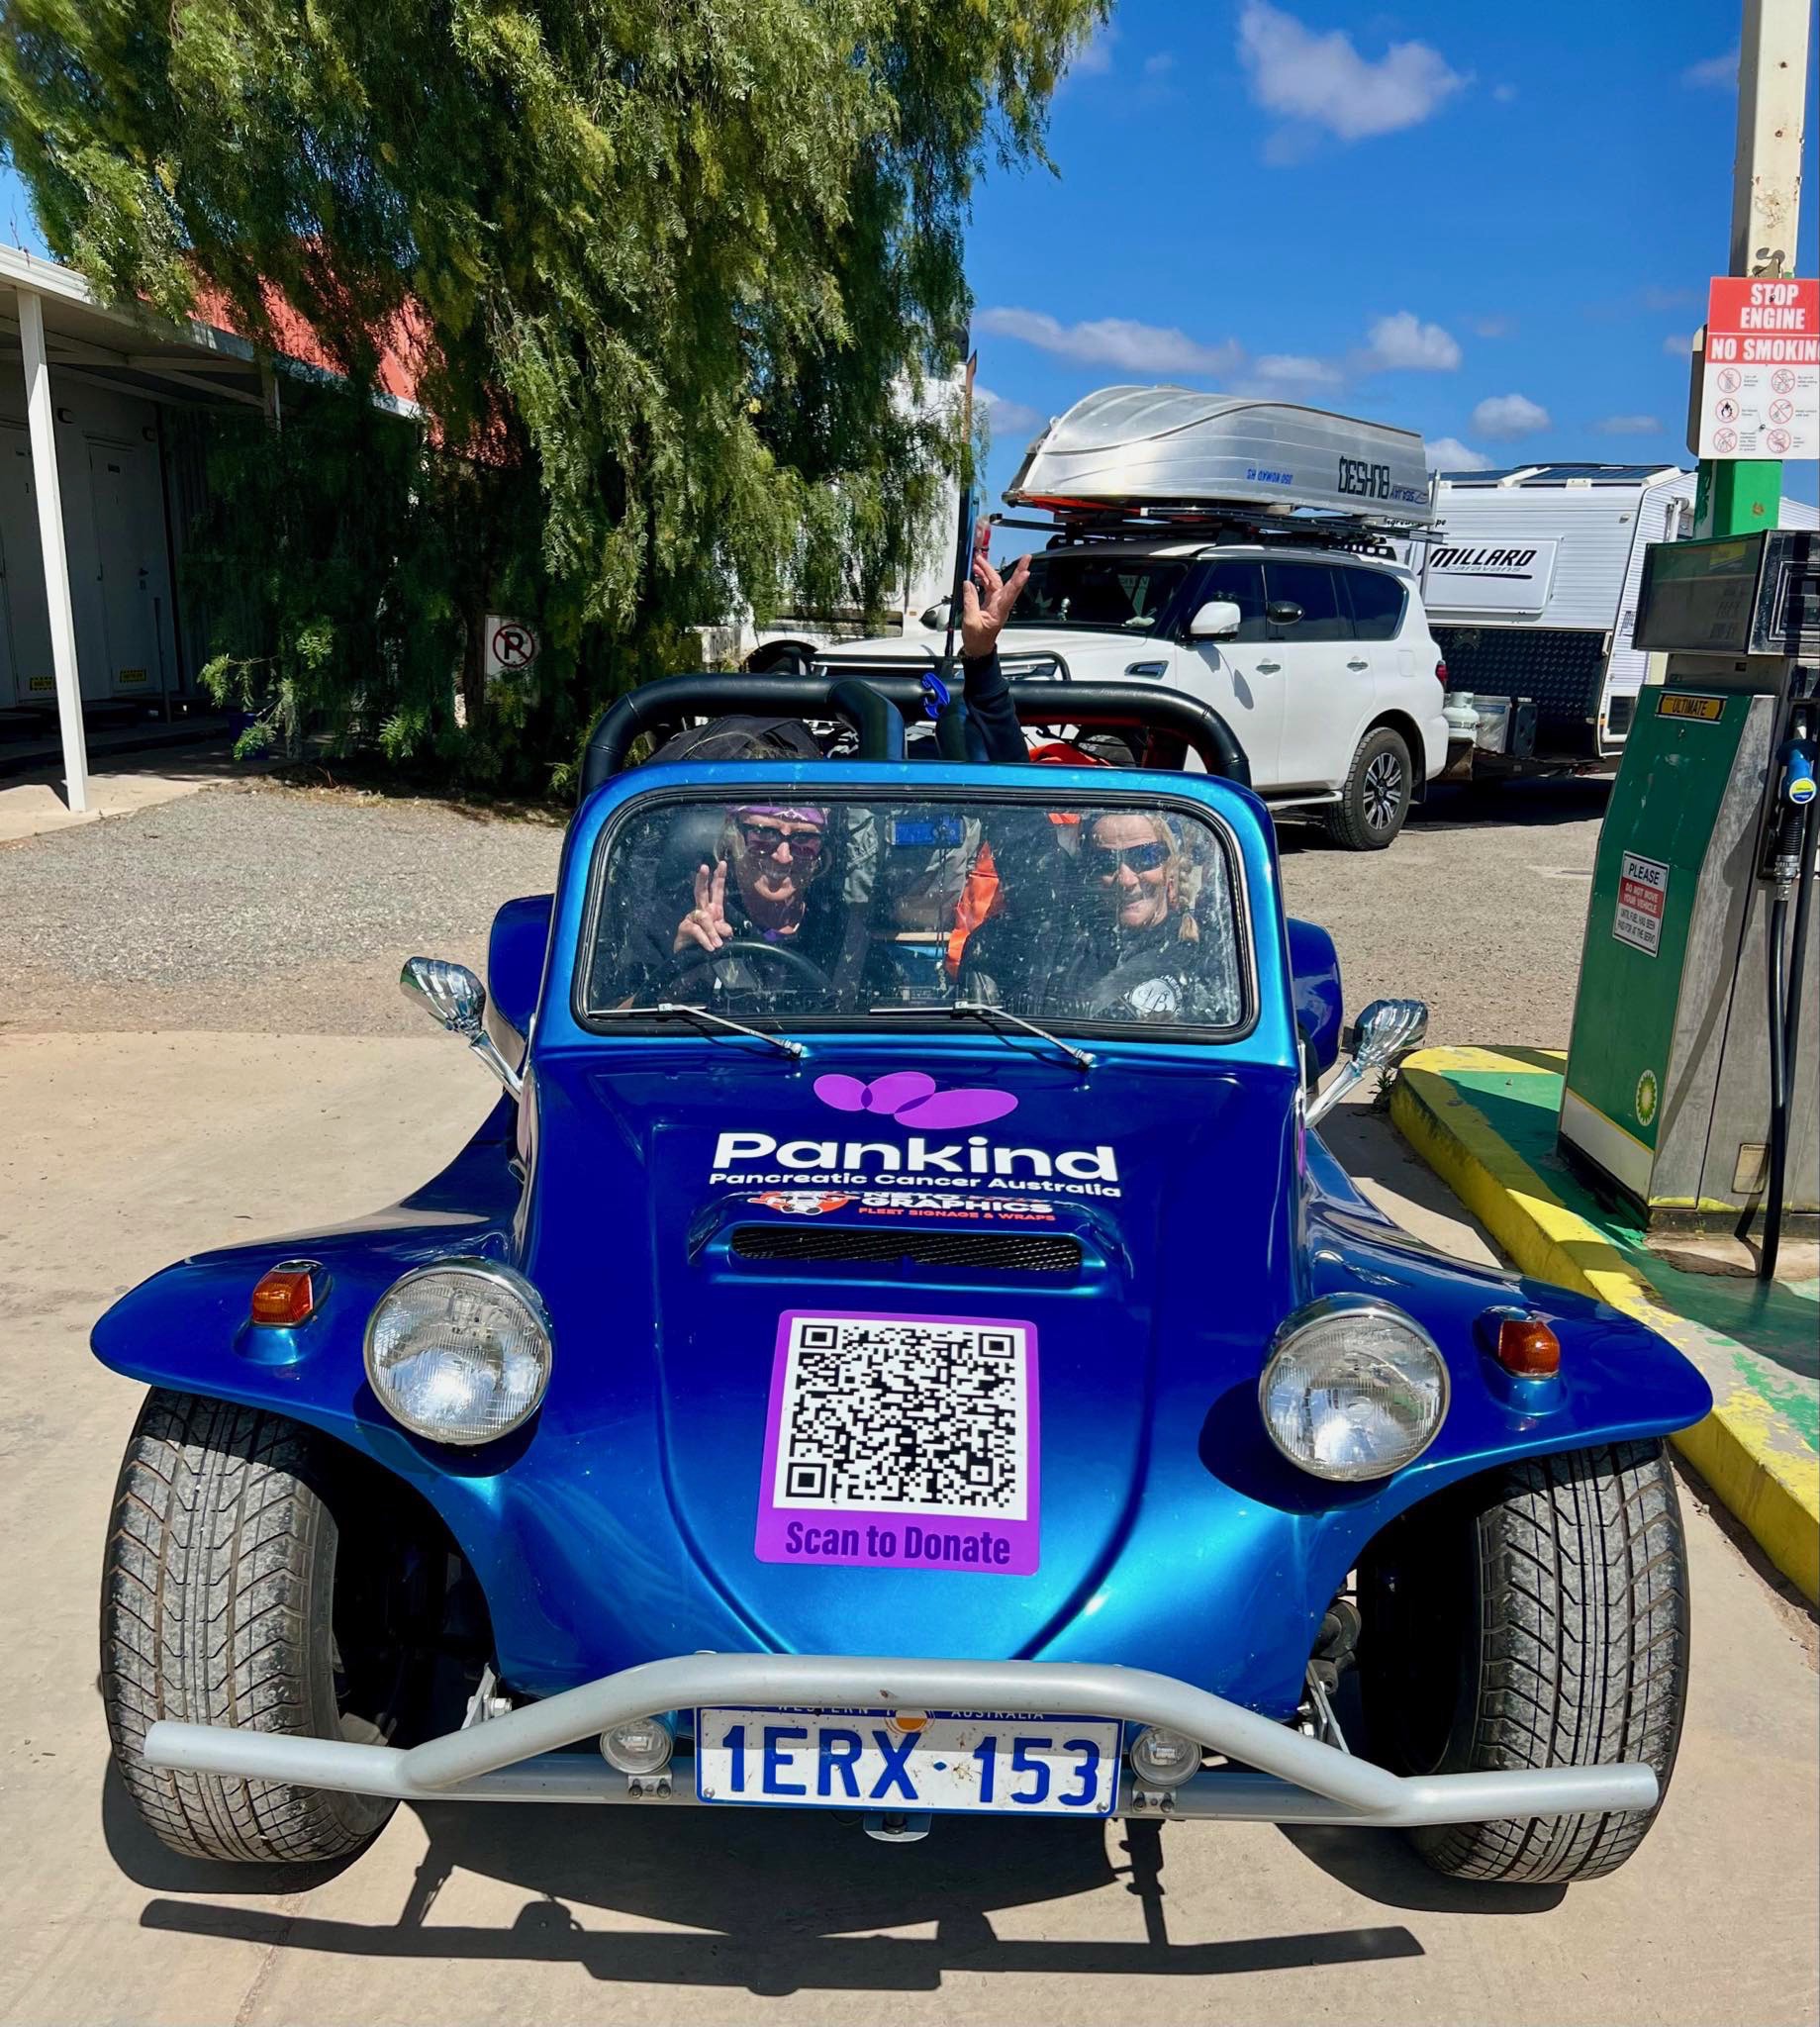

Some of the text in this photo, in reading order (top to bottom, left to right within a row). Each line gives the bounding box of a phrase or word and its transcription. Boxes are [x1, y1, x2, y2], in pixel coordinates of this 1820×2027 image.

[1751, 283, 1799, 306] STOP
[1740, 307, 1805, 330] ENGINE
[1711, 338, 1819, 361] NO SMOKIN
[1428, 547, 1537, 567] MILLARD
[1673, 697, 1708, 717] ULTIMATE
[1628, 863, 1661, 886] PLEASE
[1637, 898, 1657, 913] VEHICLE
[713, 1132, 1118, 1182] Pankind
[709, 1172, 1121, 1198] Pancreatic Cancer Australia
[858, 1207, 905, 1215] FLEET
[909, 1209, 980, 1218] SIGNAGE
[861, 1197, 1053, 1213] GRAPHICS
[785, 1521, 1010, 1565] Scan to Donate
[951, 1710, 1044, 1720] AUSTRALIA
[722, 1725, 1101, 1806] 1ERX 153
